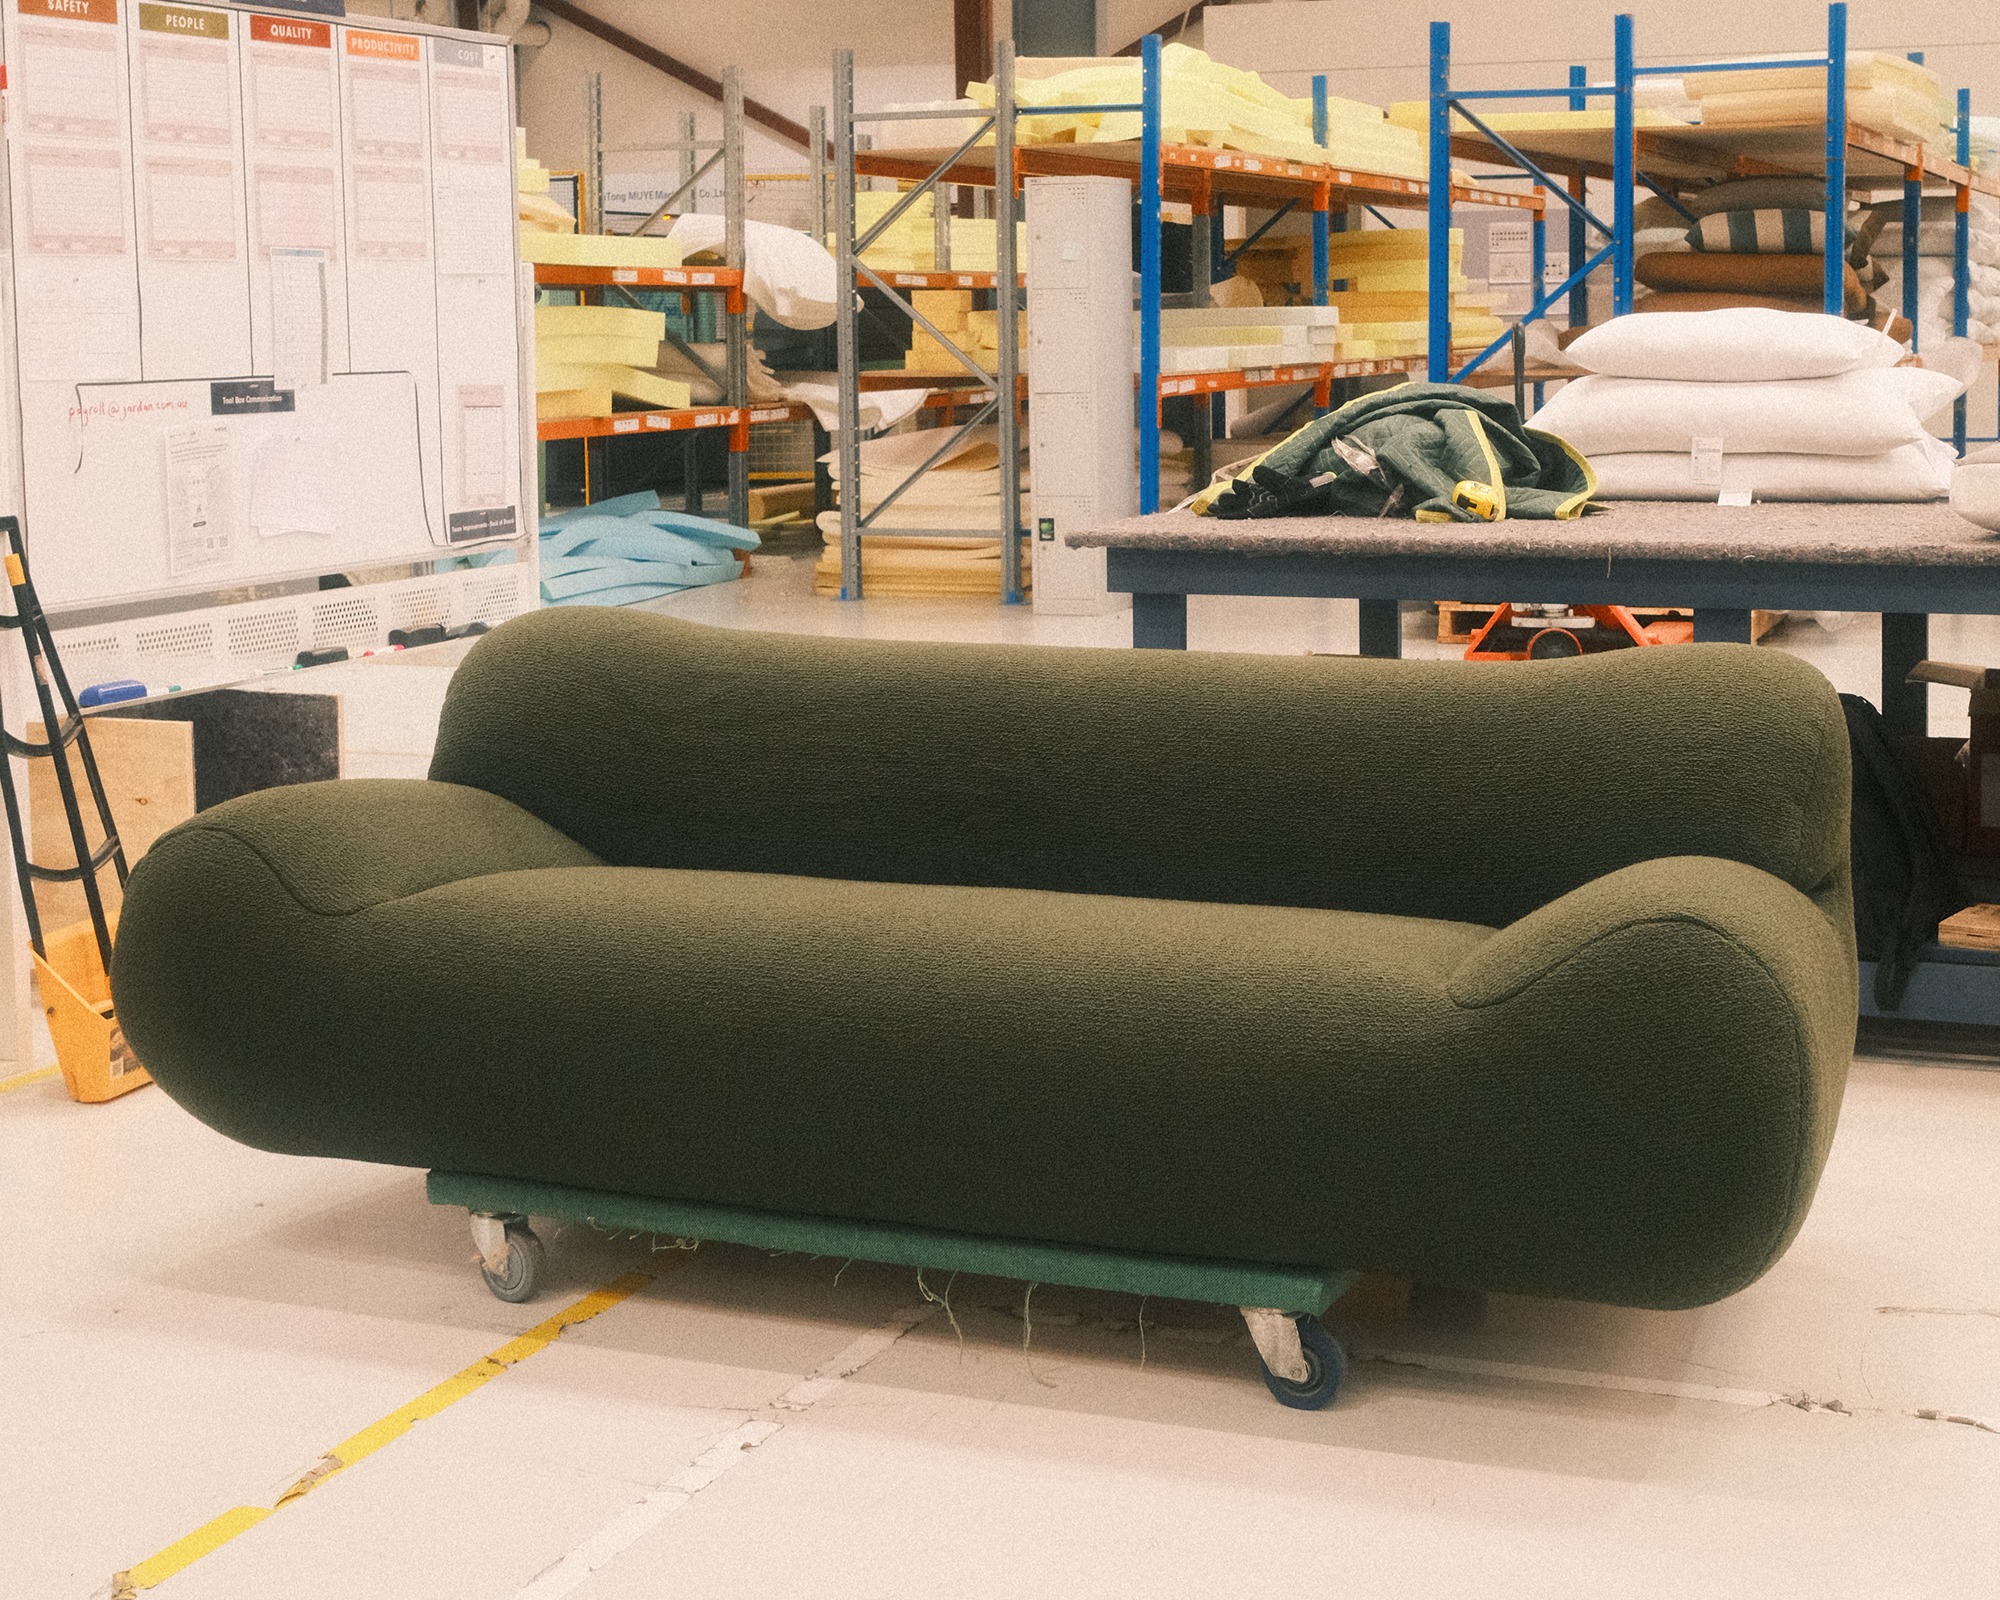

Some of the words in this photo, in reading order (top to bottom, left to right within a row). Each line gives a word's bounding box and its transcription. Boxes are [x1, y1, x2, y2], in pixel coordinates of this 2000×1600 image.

[47, 0, 90, 14] SAFETY
[165, 14, 206, 30] PEOPLE
[270, 23, 312, 40] QUALITY
[351, 37, 416, 54] PRODUCTIVITY
[458, 49, 481, 61] COST
[628, 190, 653, 200] MUYE
